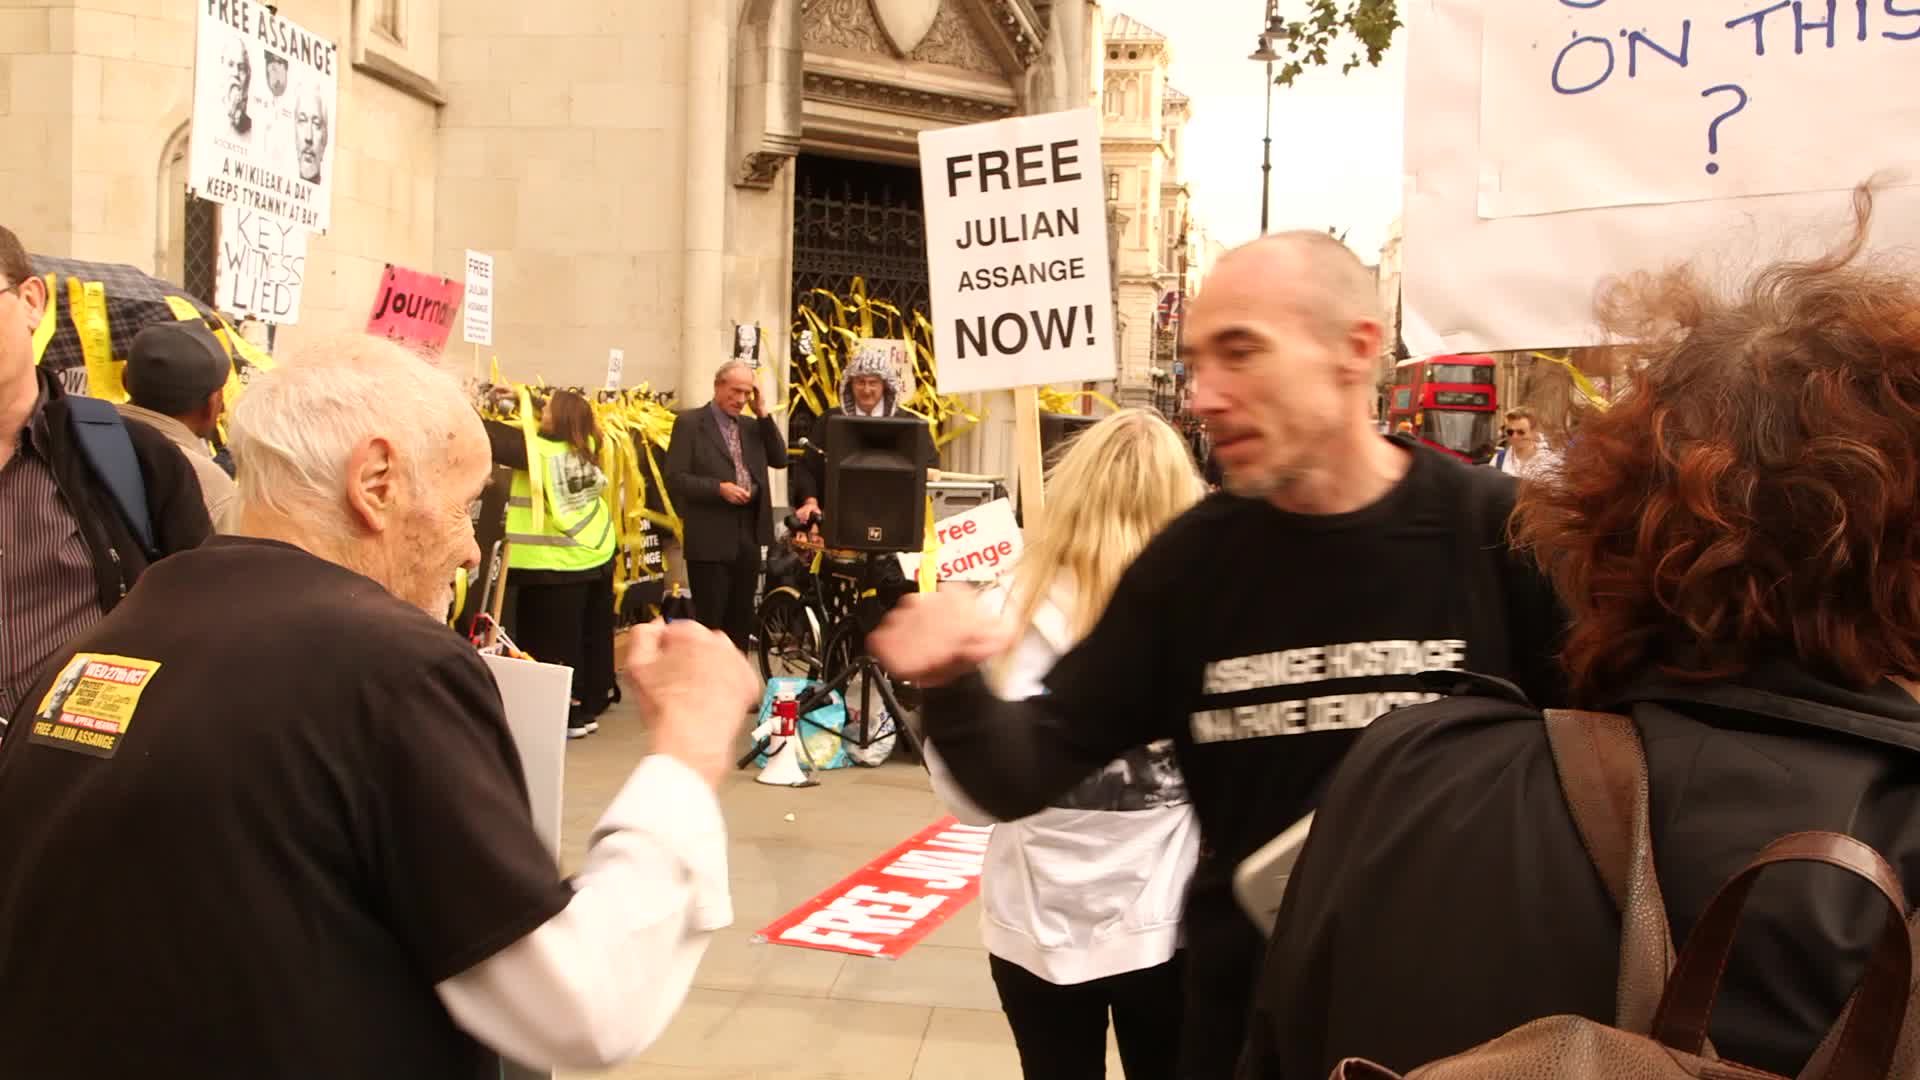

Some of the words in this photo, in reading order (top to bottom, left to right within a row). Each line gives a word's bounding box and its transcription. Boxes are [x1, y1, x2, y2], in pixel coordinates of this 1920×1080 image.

[257, 11, 332, 76] ASSANGE
[1551, 20, 1691, 95] ON
[1725, 0, 1920, 55] THIS
[1701, 84, 1747, 175] ?
[222, 157, 230, 175] A
[234, 160, 282, 194] WIKILEAK
[285, 180, 292, 196] A
[294, 183, 313, 202] DAY
[946, 139, 1082, 197] FREE
[206, 176, 239, 202] KEEPS
[243, 187, 287, 217] TYRANNY
[289, 205, 301, 222] AT
[302, 209, 319, 228] BAY
[236, 208, 294, 257] KEY
[956, 207, 1080, 249] JULIAN
[224, 241, 305, 286] WITNESS
[468, 257, 489, 278] FREE
[957, 257, 1086, 293] ASSANGE
[232, 273, 292, 316] LIED
[954, 304, 1096, 359] NOW!
[938, 519, 977, 546] ree
[914, 540, 1013, 581] sange
[33, 721, 52, 736] FREE
[52, 725, 78, 742] JULIAN
[76, 730, 116, 750] ASSANGE
[779, 885, 950, 953] FREE
